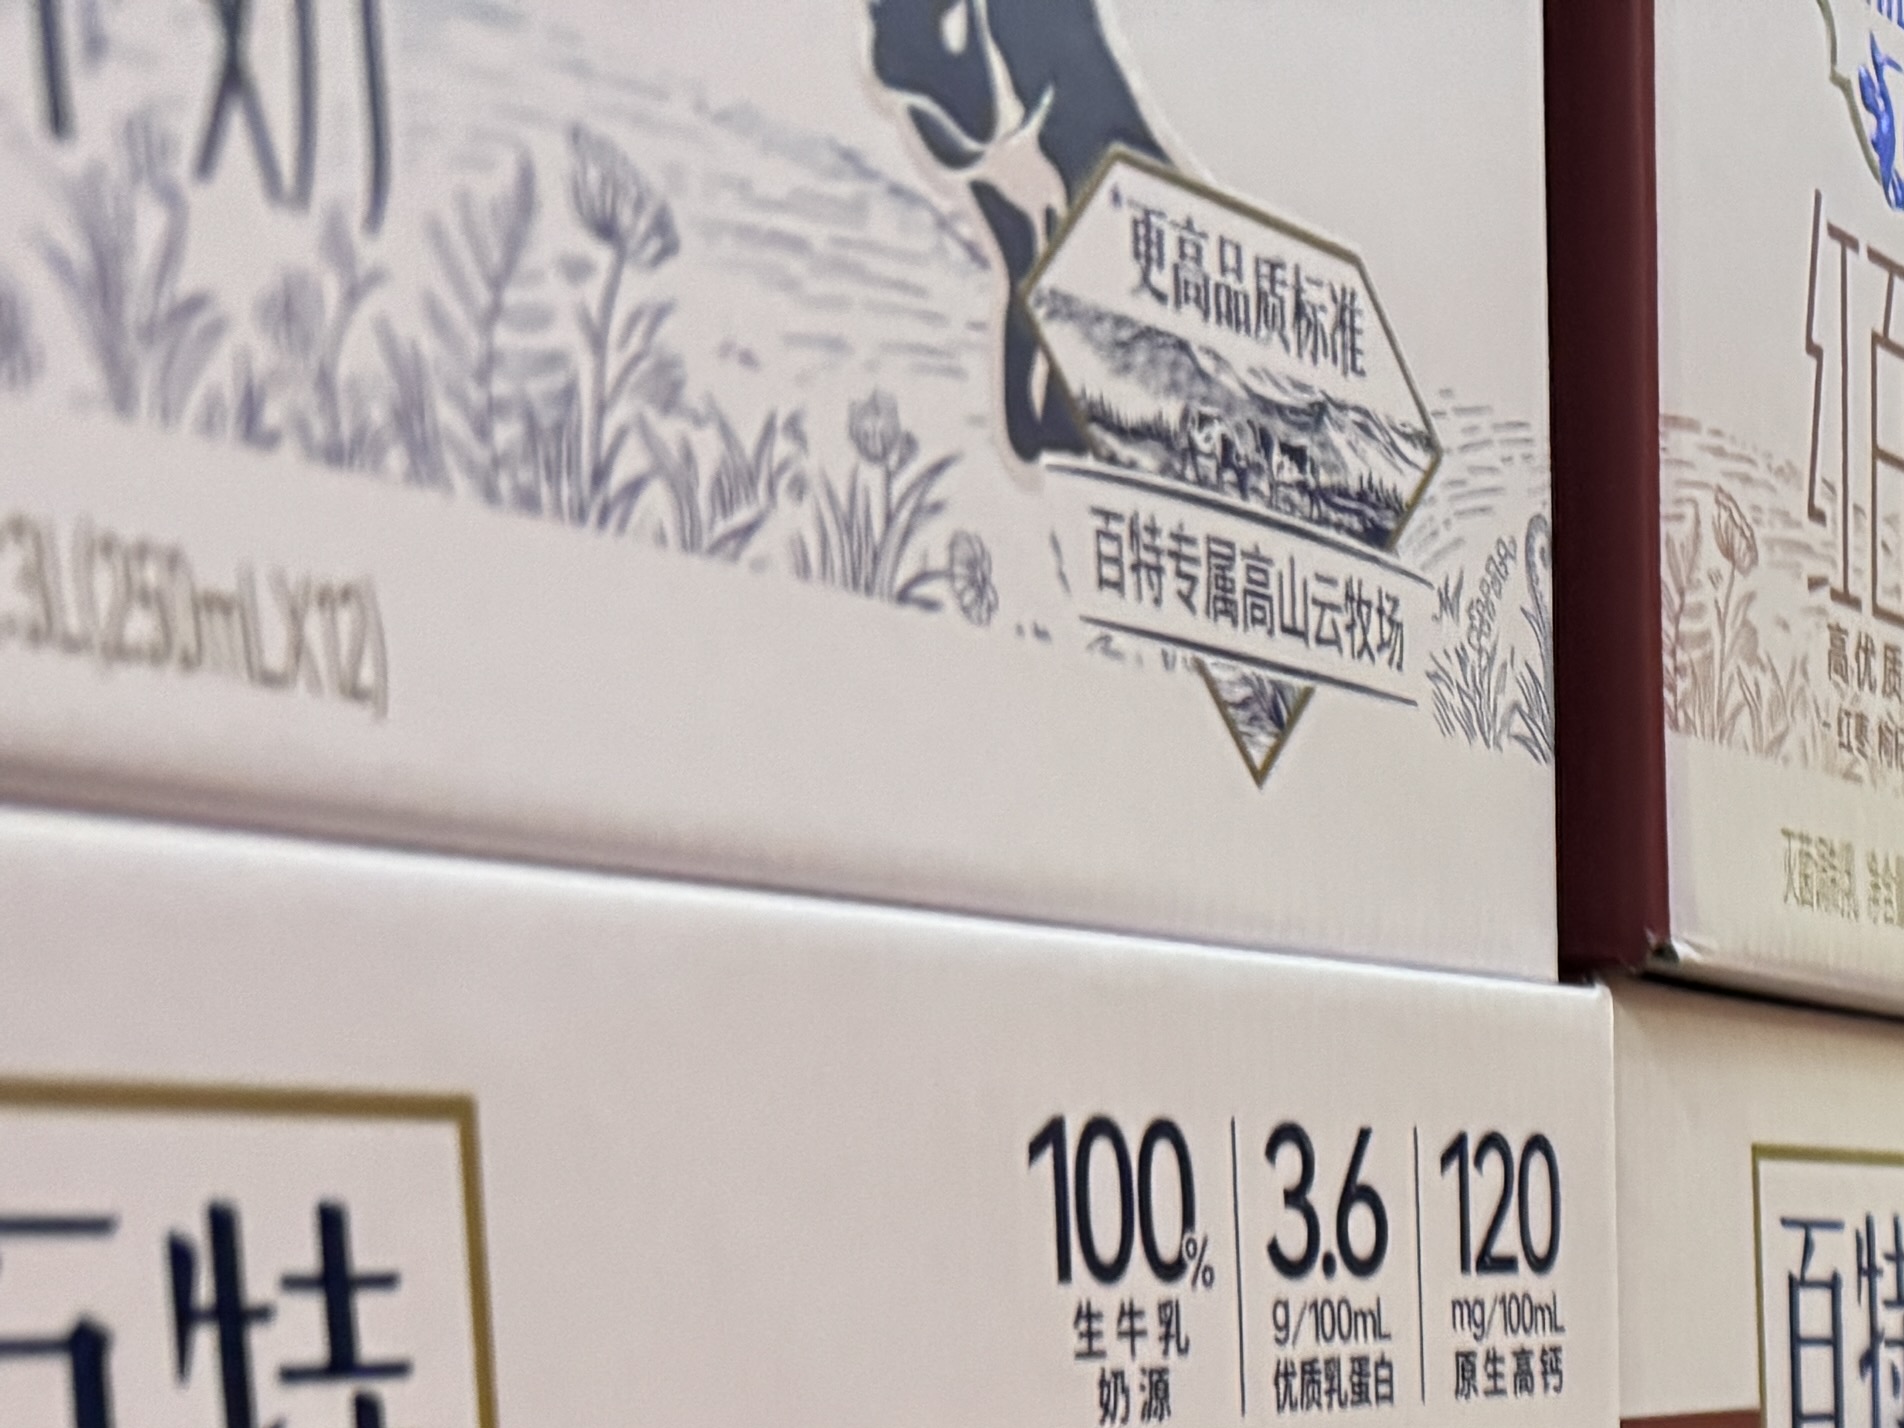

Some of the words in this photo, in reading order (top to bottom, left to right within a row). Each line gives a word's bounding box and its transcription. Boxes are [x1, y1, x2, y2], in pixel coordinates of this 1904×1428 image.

[1130, 205, 1366, 378] 更高品质标准
[1090, 504, 1406, 673] 百特专属高山云牧场
[1027, 1113, 1215, 1291] 100%
[1264, 1120, 1389, 1281] 3.6
[1439, 1129, 1563, 1278] 120
[1073, 1298, 1190, 1360] 生牛乳
[1272, 1296, 1391, 1347] g/100mL
[1451, 1291, 1566, 1338] mg/100mL
[1098, 1366, 1171, 1427] 奶源
[1273, 1352, 1394, 1416] 优质乳蛋白
[1453, 1345, 1564, 1400] 原生高钙
